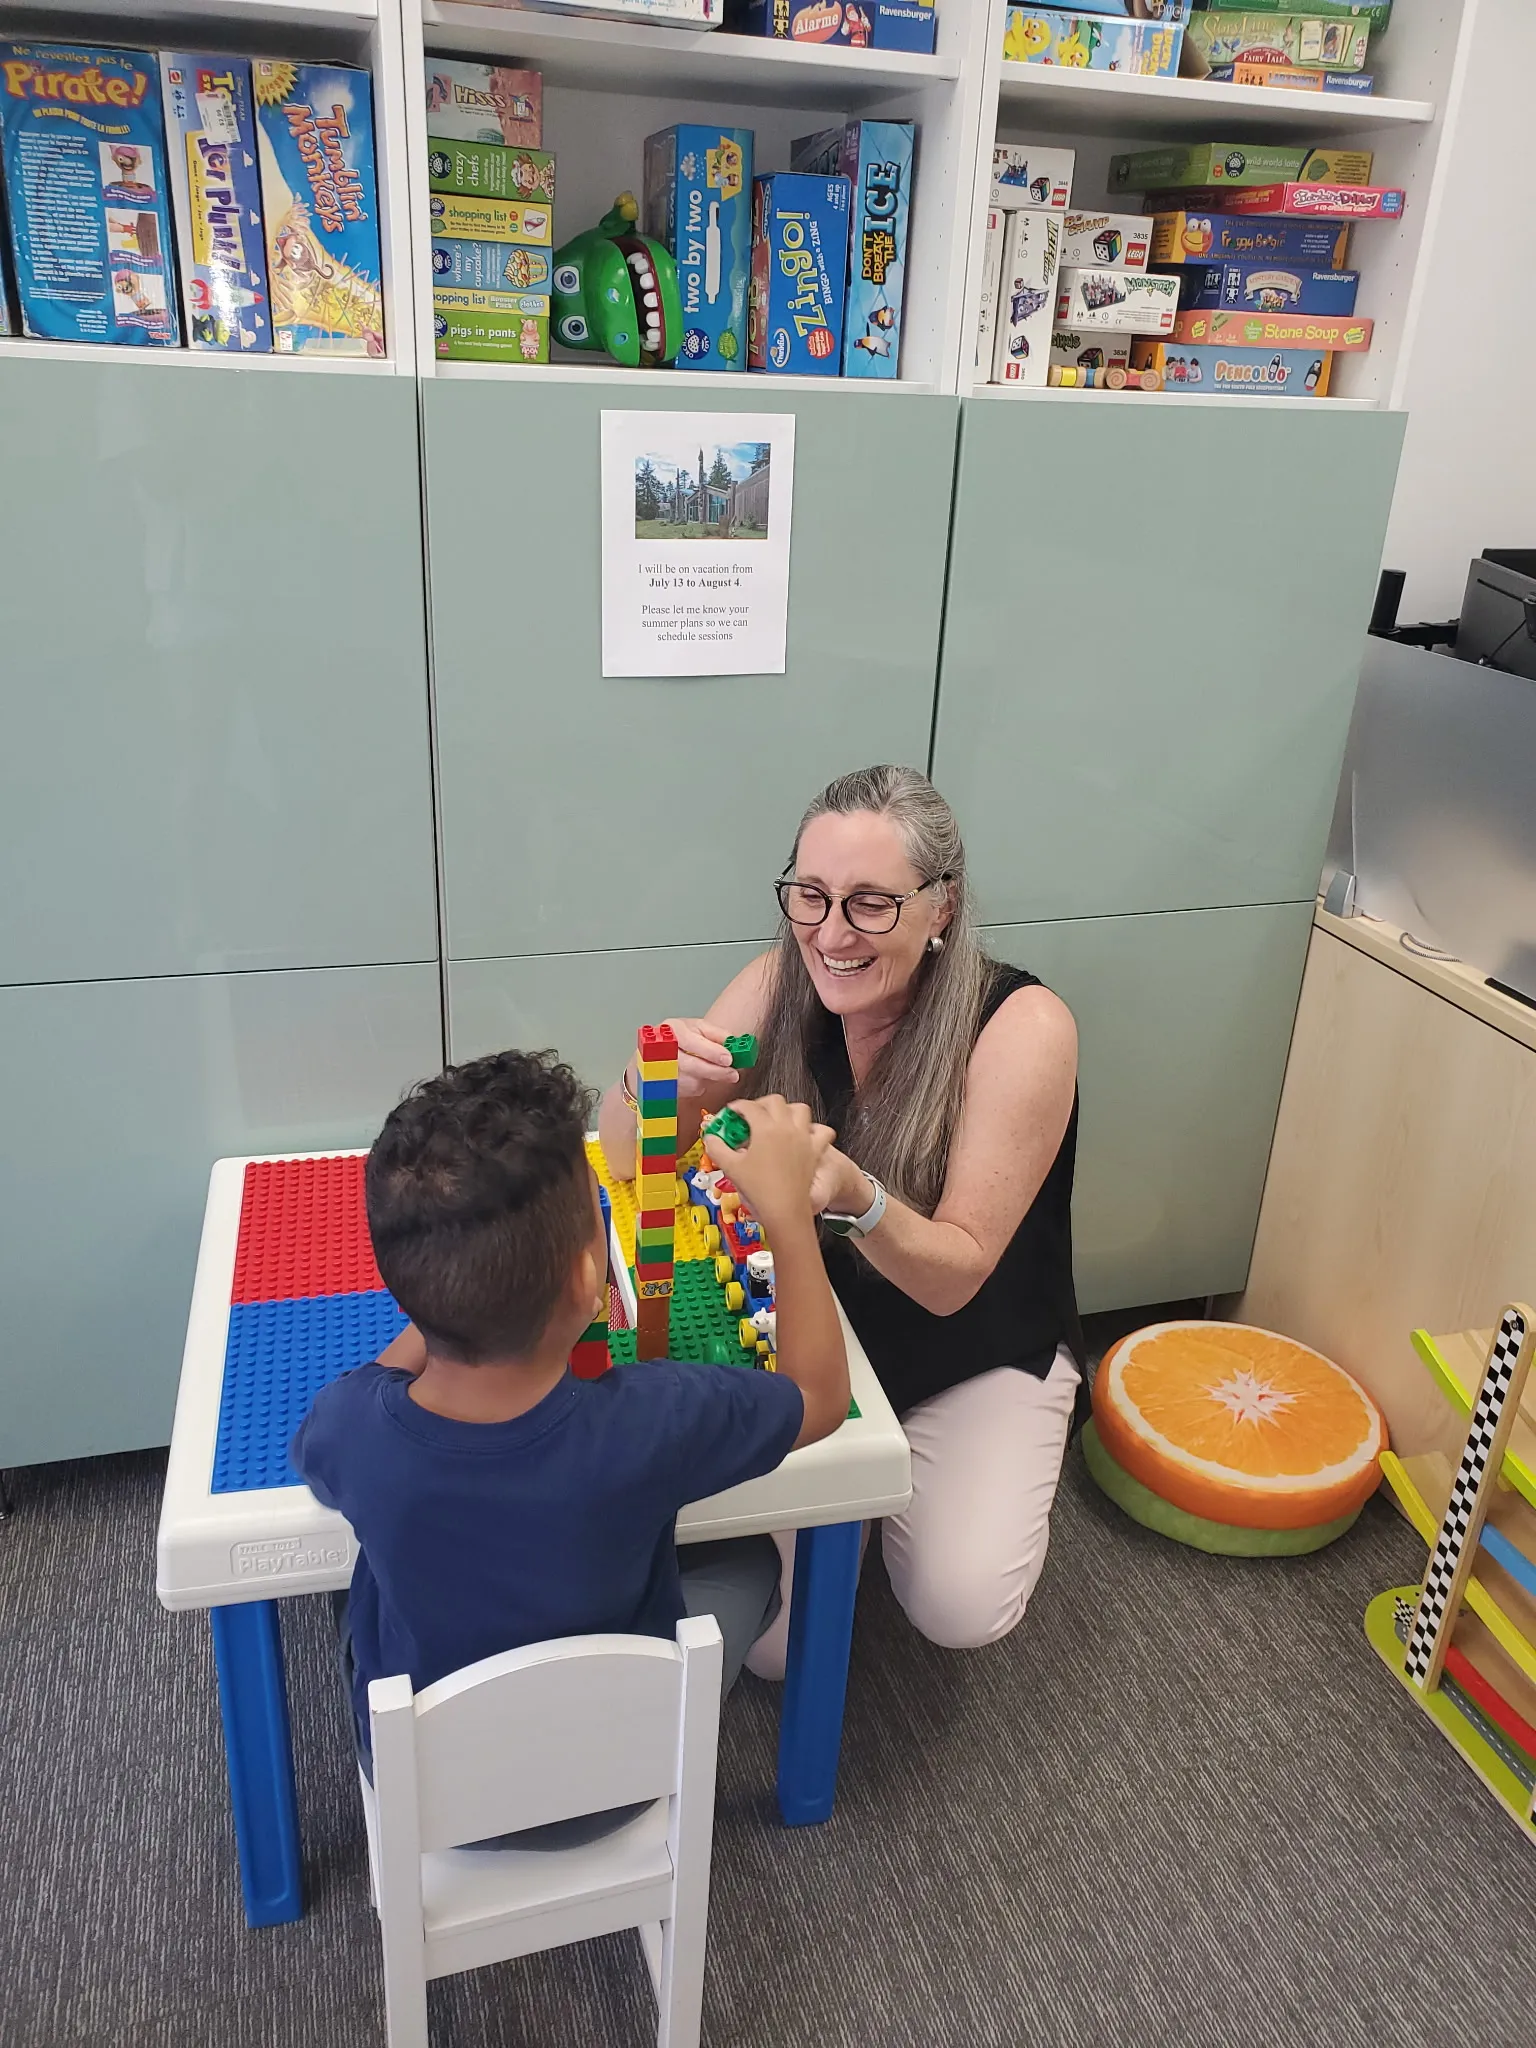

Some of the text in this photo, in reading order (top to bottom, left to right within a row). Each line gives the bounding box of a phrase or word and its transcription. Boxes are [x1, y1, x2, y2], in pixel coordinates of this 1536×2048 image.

[879, 4, 932, 21] Ravensburger
[794, 13, 839, 36] Alarme
[96, 56, 117, 65] pas
[120, 58, 133, 71] le
[1243, 53, 1264, 63] FAIRY
[3, 62, 148, 107] Pirate!
[1326, 75, 1371, 89] Ravensburger
[97, 124, 105, 132] LA
[282, 103, 344, 233] Monkeys
[455, 151, 468, 186] crazy
[1246, 156, 1300, 168] wild world lotto
[467, 155, 479, 187] chefs
[835, 184, 841, 193] up
[1053, 193, 1066, 201] LEGO
[864, 162, 900, 234] ICE
[449, 205, 492, 223] shopping
[494, 209, 507, 222] list
[810, 220, 821, 248] ZING
[1133, 232, 1149, 240] 3835
[682, 189, 705, 313] two by two
[863, 233, 874, 278] DON'T
[873, 231, 885, 283] BREAK
[884, 235, 895, 263] THE
[1127, 249, 1144, 258] LEGO
[452, 243, 462, 283] where's
[465, 256, 474, 272] my
[473, 242, 484, 288] cupcake?
[816, 252, 825, 272] with
[776, 208, 828, 338] Zingo!
[1312, 272, 1355, 283] Ravensburger
[820, 274, 833, 305] BINGO
[1124, 277, 1177, 298] MONSTER
[472, 293, 487, 305] list
[519, 299, 545, 309] clothes
[450, 324, 472, 338] pigs
[475, 324, 485, 336] in
[488, 327, 517, 339] pants
[1264, 323, 1303, 339] Stone
[1305, 325, 1339, 344] Soup
[701, 335, 709, 353] TOYS
[638, 563, 753, 574] I will be on vacation from
[649, 578, 742, 589] July 13 to August 4.
[641, 604, 749, 615] Please let me know your
[641, 618, 748, 629] summer plans so we can
[657, 631, 733, 641] schedule sessions
